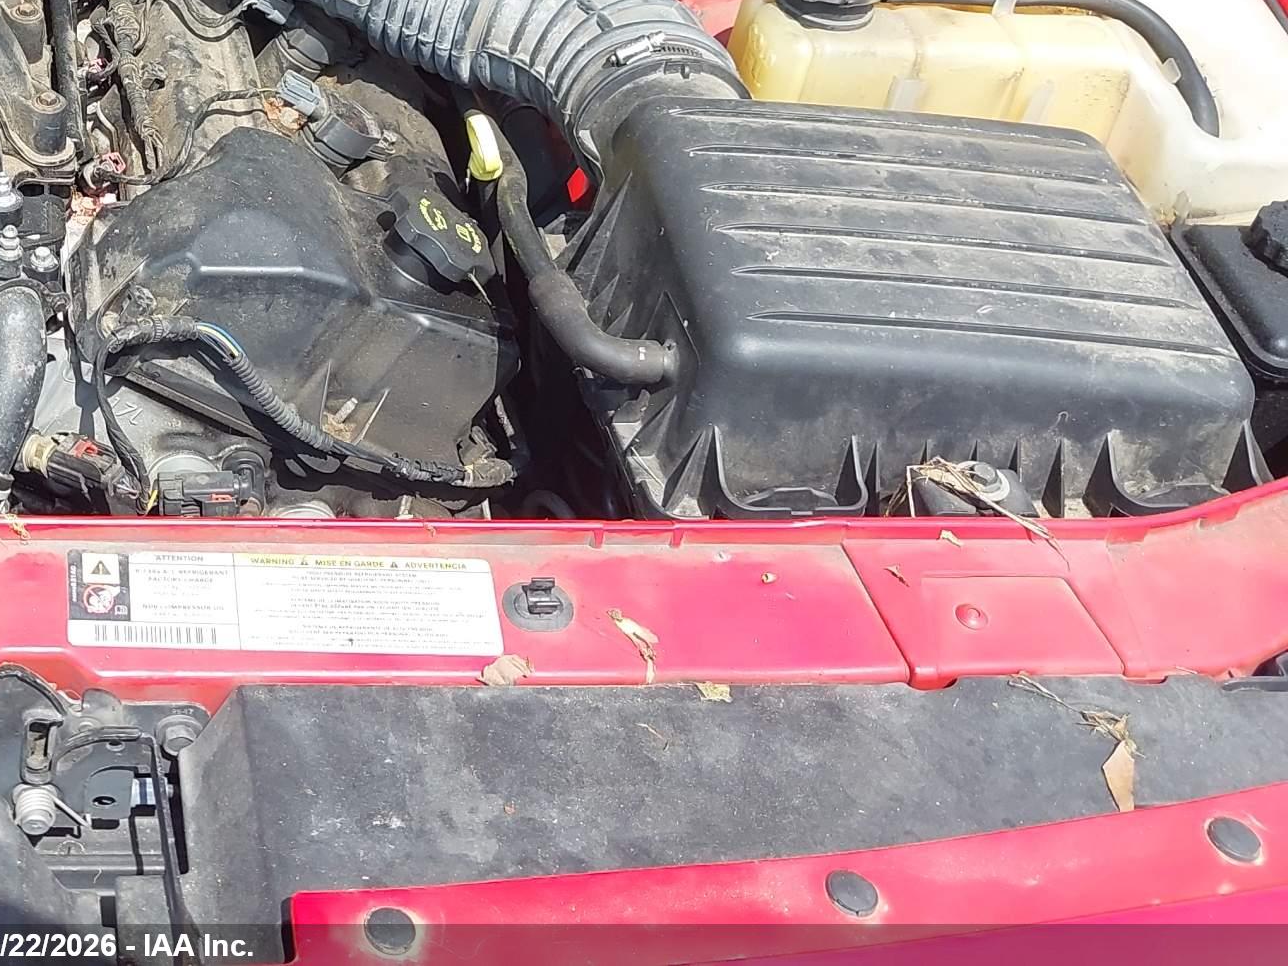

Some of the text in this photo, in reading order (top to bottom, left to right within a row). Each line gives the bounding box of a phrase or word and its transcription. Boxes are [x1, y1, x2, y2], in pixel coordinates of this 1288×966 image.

[155, 554, 204, 562] ATTENTION
[250, 557, 468, 570] WARNING MISE EN GARDE ADVERTENCIA
